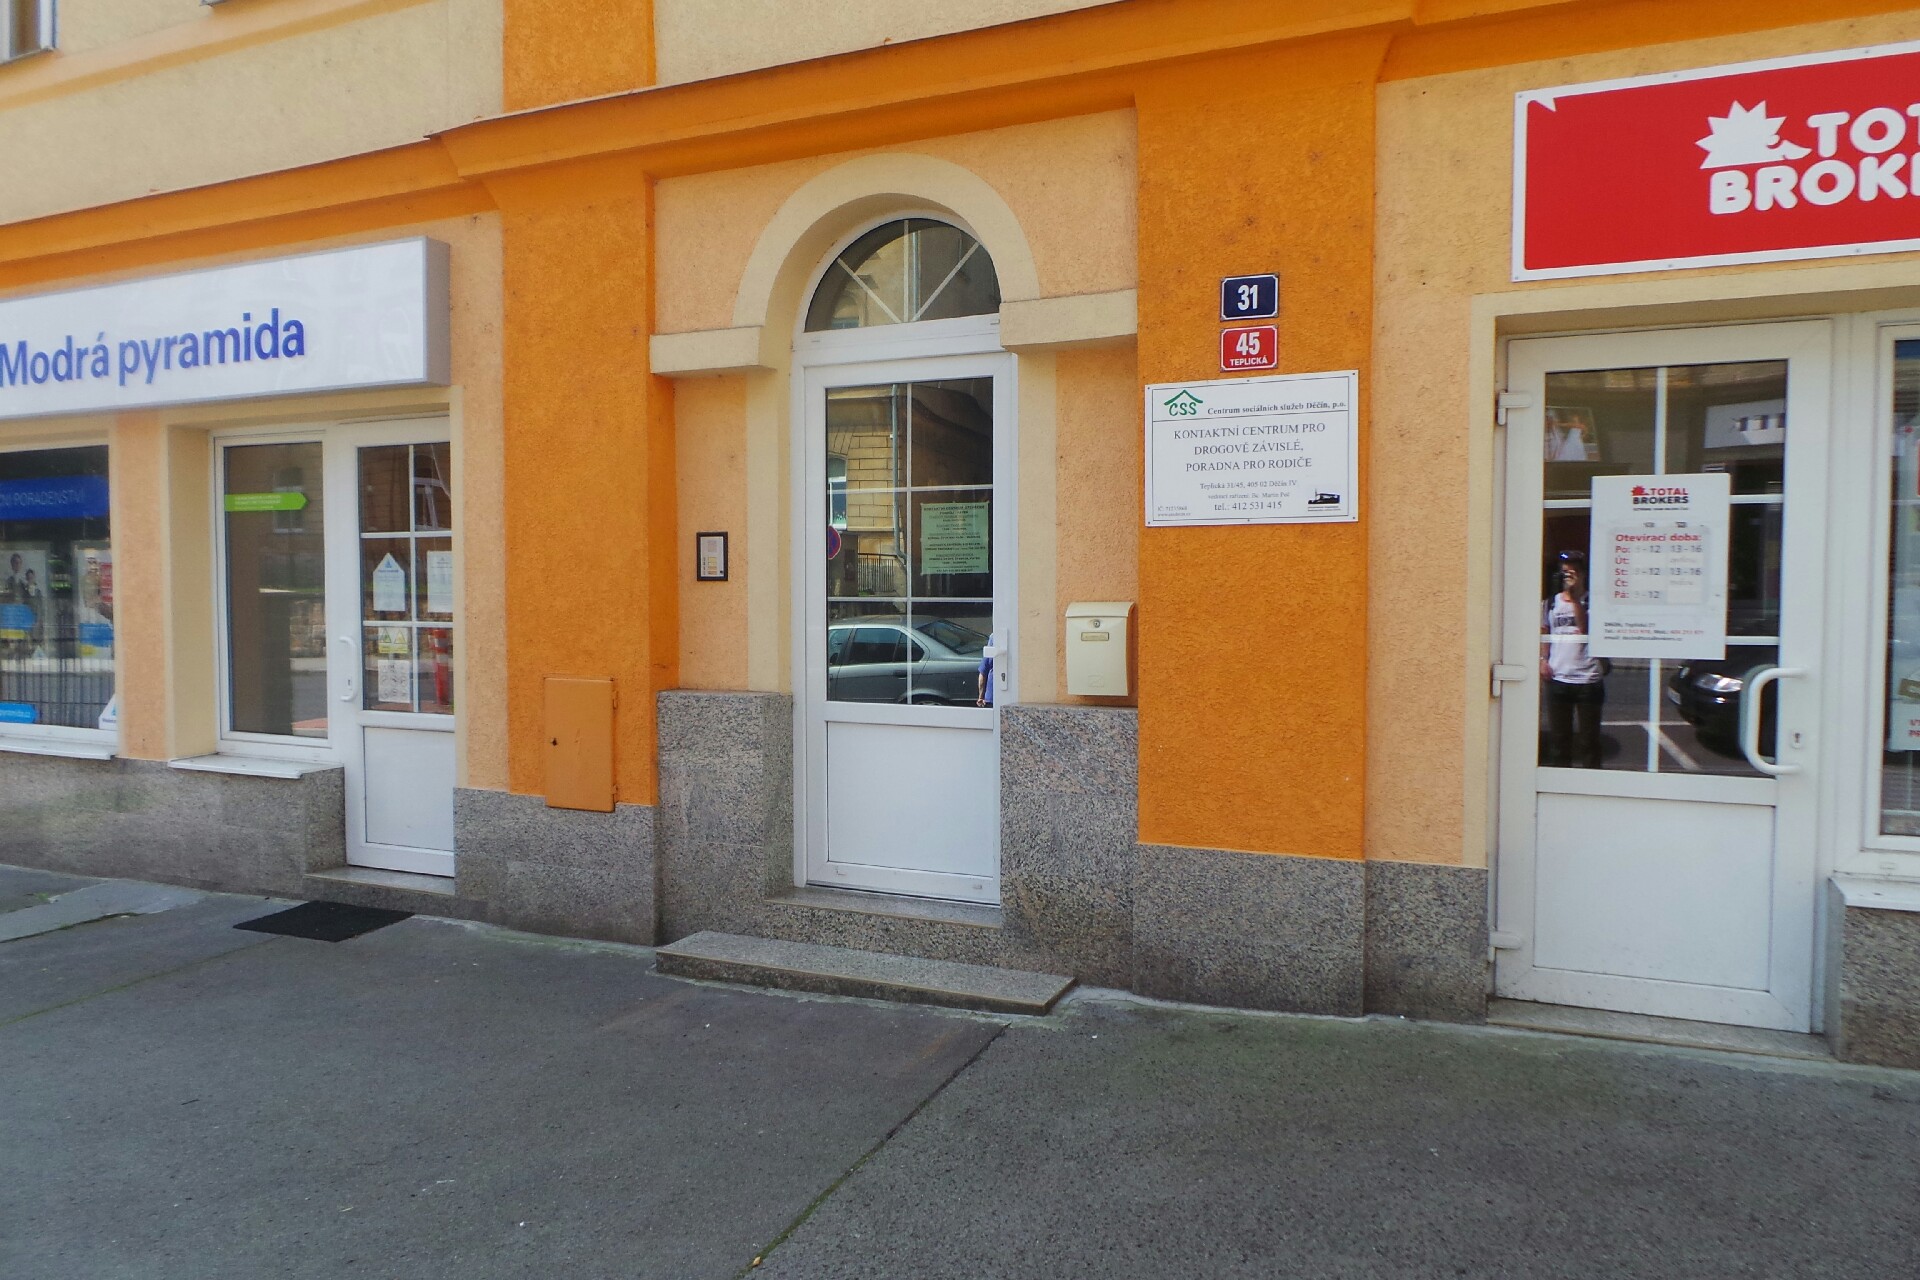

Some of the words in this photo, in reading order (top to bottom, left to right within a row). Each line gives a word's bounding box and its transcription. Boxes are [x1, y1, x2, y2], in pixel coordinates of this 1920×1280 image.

[1709, 152, 1920, 215] BROK
[1237, 284, 1259, 311] 31
[0, 331, 110, 388] Modrá
[118, 307, 305, 386] pyramida
[1236, 331, 1260, 356] 45
[1229, 355, 1268, 366] TEPLICKÁ
[1169, 402, 1197, 416] CSS
[1207, 407, 1241, 415] Centrum
[1242, 404, 1278, 413] sociálních
[1280, 402, 1304, 411] služeb
[1174, 425, 1239, 439] KONTAKTNÍ
[1242, 424, 1299, 436] CENTRUM
[1302, 422, 1326, 433] PRO
[1194, 442, 1249, 455] DROGOVÉ
[1186, 459, 1240, 472] PORADNA
[1243, 459, 1266, 470] PRO
[1268, 457, 1312, 468] RODIČE
[1650, 488, 1688, 496] TOTAL
[1232, 502, 1247, 510] 412
[1249, 501, 1264, 510] 531
[1266, 500, 1282, 509] 415
[1633, 496, 1689, 504] BROKERS
[1670, 533, 1702, 541] doba:
[1649, 545, 1661, 553] 12
[1614, 568, 1629, 576] St:
[1649, 568, 1660, 576] 12
[1648, 590, 1660, 598] 12
